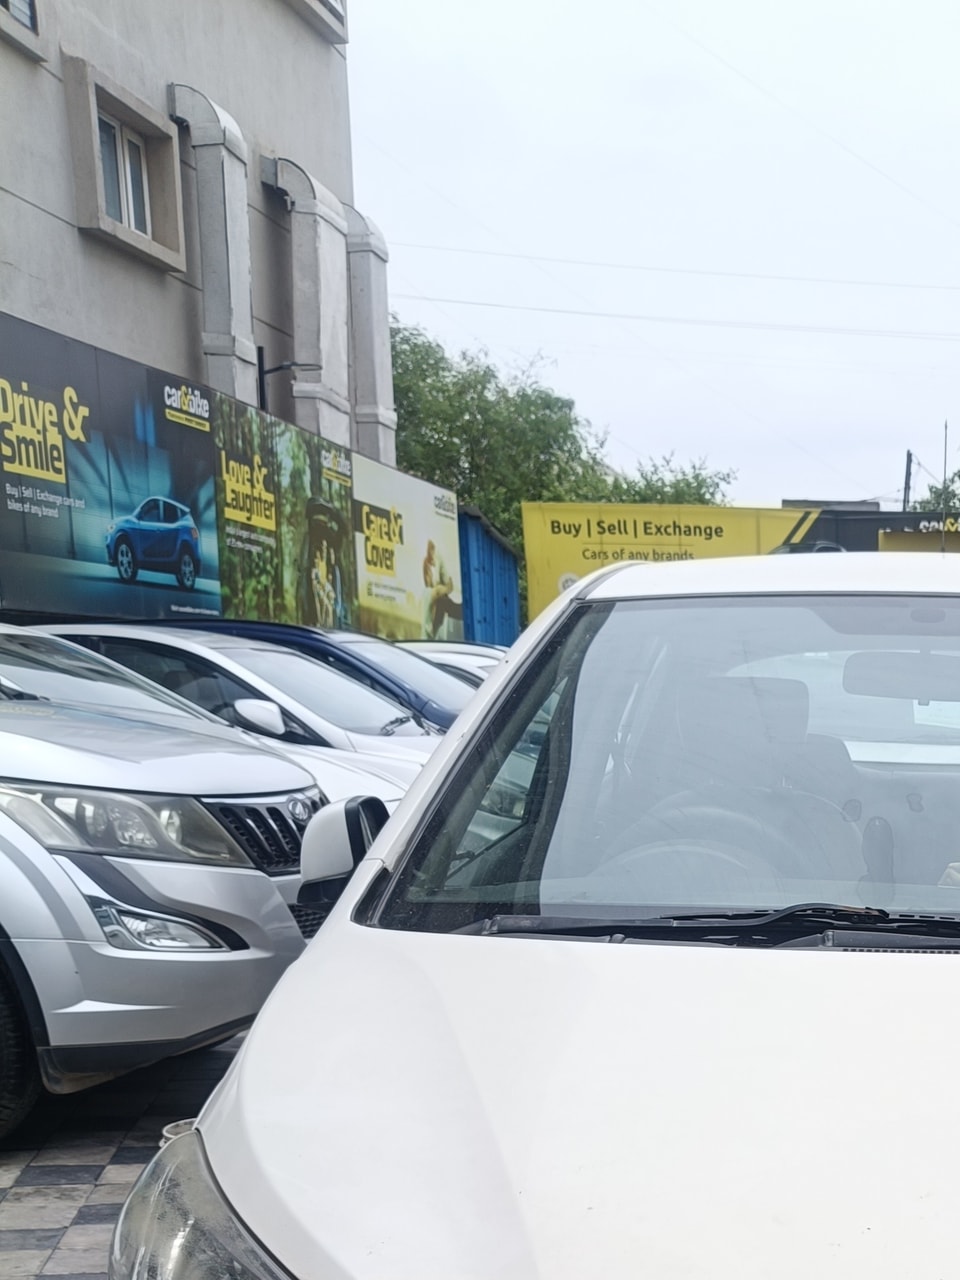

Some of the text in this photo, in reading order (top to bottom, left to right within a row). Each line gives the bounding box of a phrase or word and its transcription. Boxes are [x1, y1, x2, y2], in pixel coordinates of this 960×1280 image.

[0, 378, 89, 443] Drive &
[164, 385, 210, 419] car&bike
[0, 422, 63, 475] Smile
[221, 450, 251, 486] Love
[222, 483, 275, 521] Laughter
[362, 505, 388, 540] Care
[550, 519, 582, 538] Buy
[596, 519, 628, 536] Sell
[643, 520, 724, 540] Exchange
[365, 536, 395, 571] Cover
[582, 548, 695, 561] Cars of any brands
